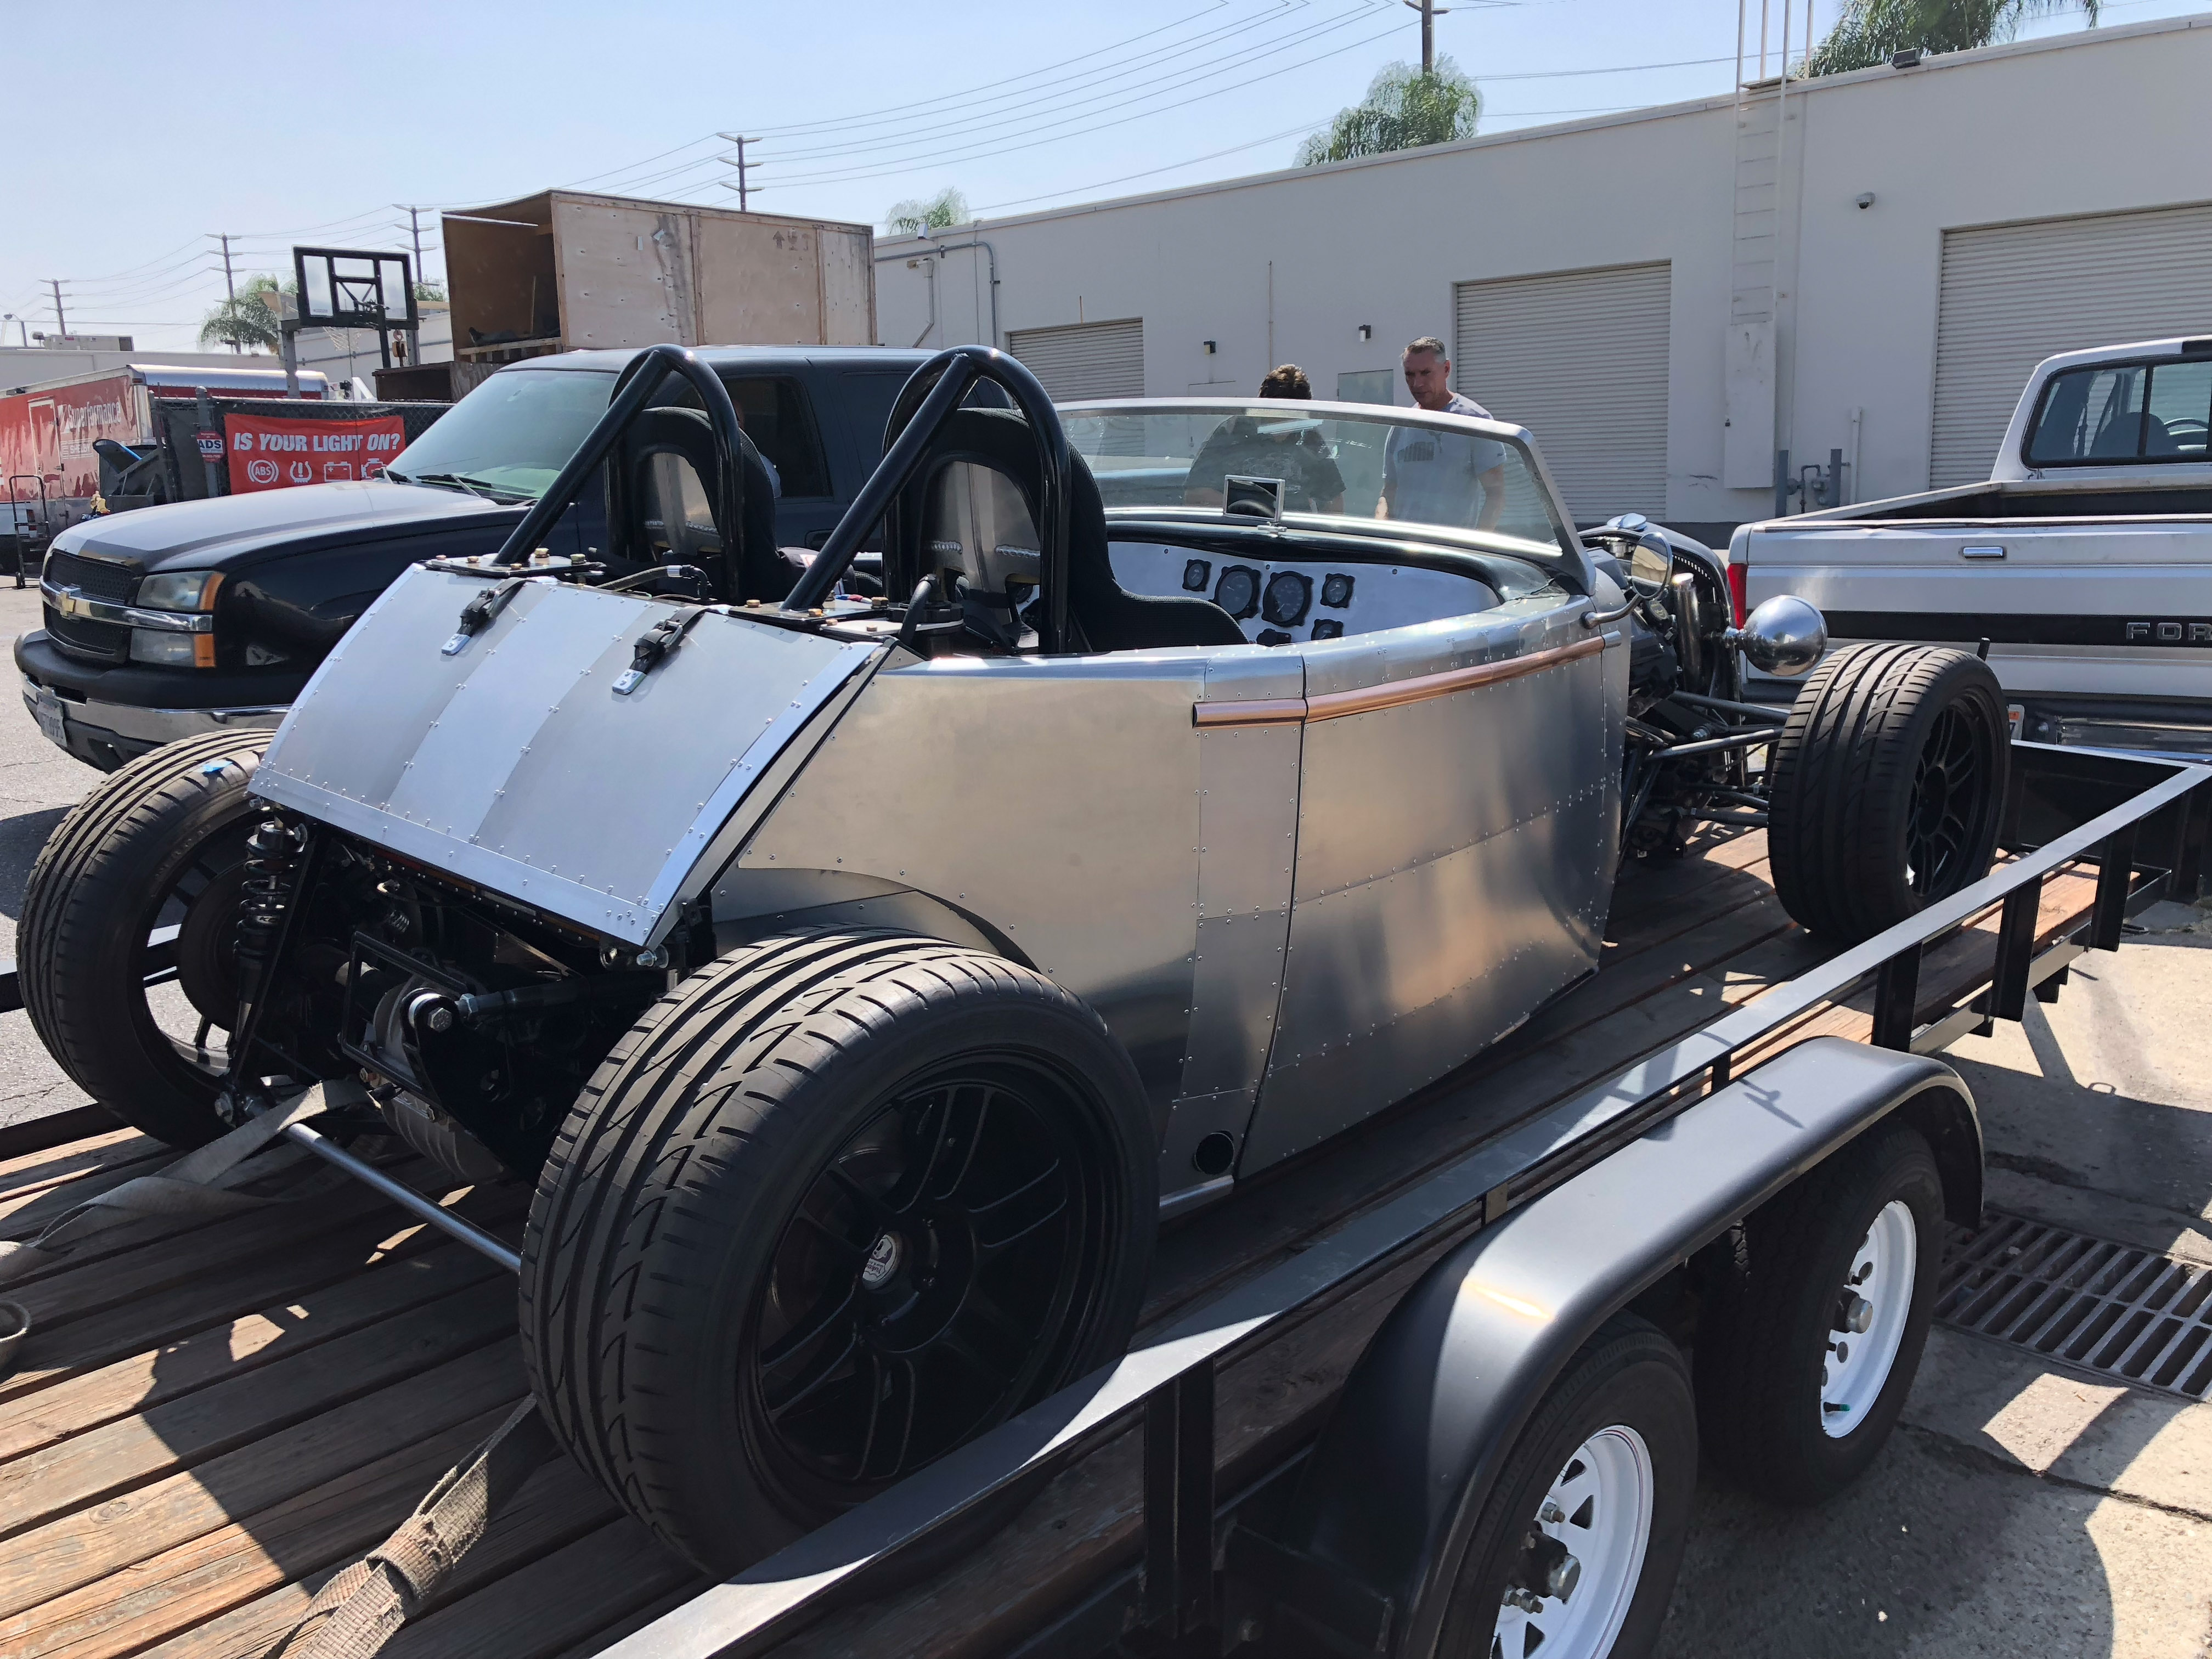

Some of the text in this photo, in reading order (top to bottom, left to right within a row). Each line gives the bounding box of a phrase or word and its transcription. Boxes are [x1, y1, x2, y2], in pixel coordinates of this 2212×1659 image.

[67, 401, 121, 433] Superformance
[199, 440, 221, 449] ADS
[233, 432, 400, 452] IS YOUR LIGHT ON?
[70, 443, 91, 454] SHELBY
[255, 466, 272, 476] ABS
